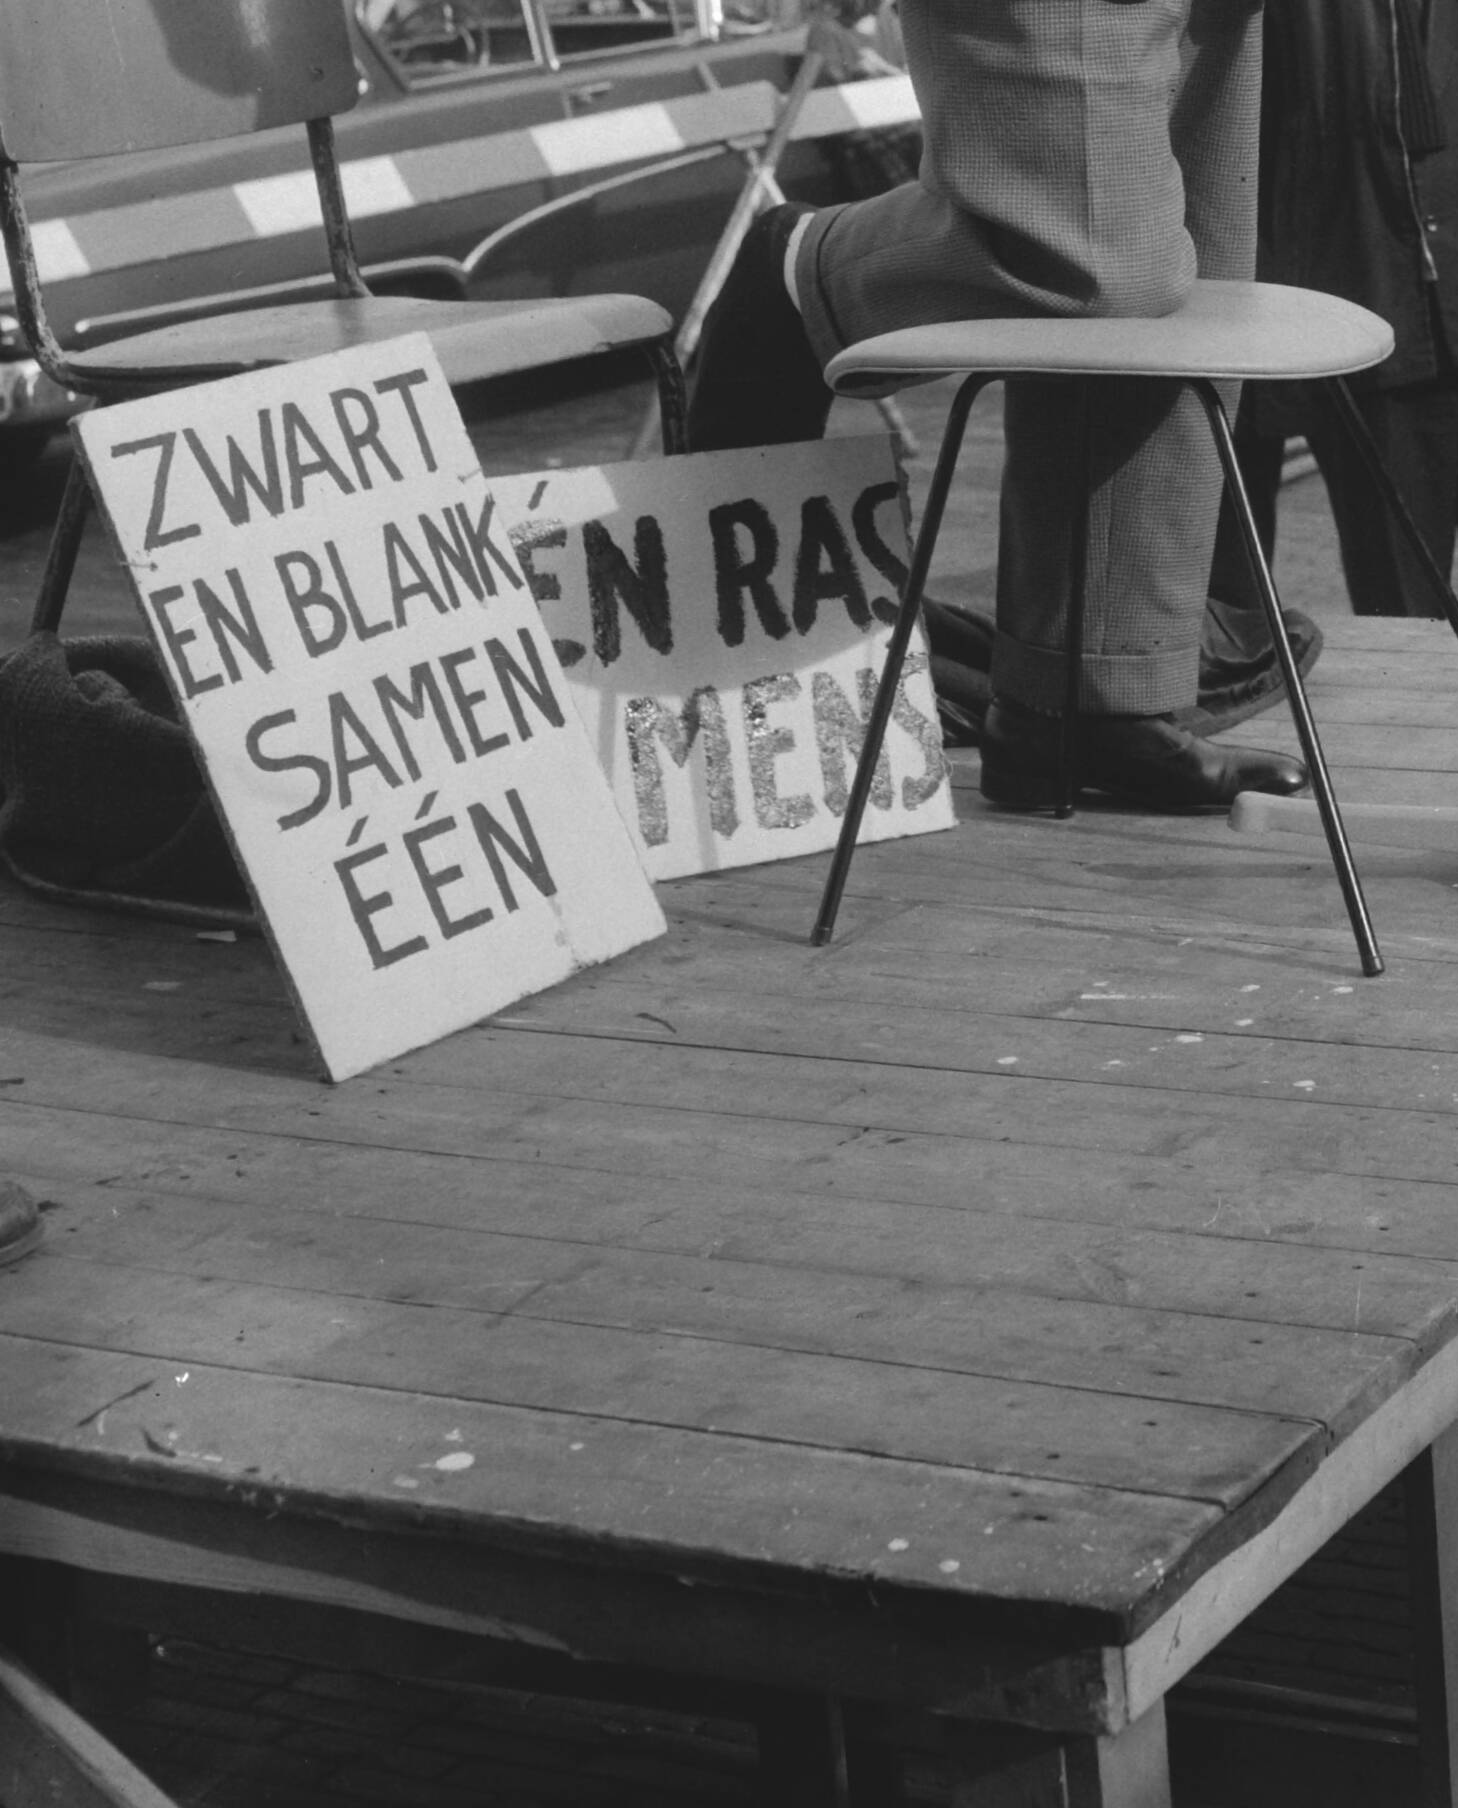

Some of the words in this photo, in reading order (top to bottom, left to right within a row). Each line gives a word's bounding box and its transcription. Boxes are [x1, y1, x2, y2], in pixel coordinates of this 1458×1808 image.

[110, 368, 438, 550] ZWART
[148, 568, 275, 700] EN
[273, 493, 526, 659] BLANK
[708, 481, 910, 648] RAS
[245, 627, 566, 832] SAMEN
[624, 651, 946, 848] MENS
[333, 788, 558, 971] ÉÉN
